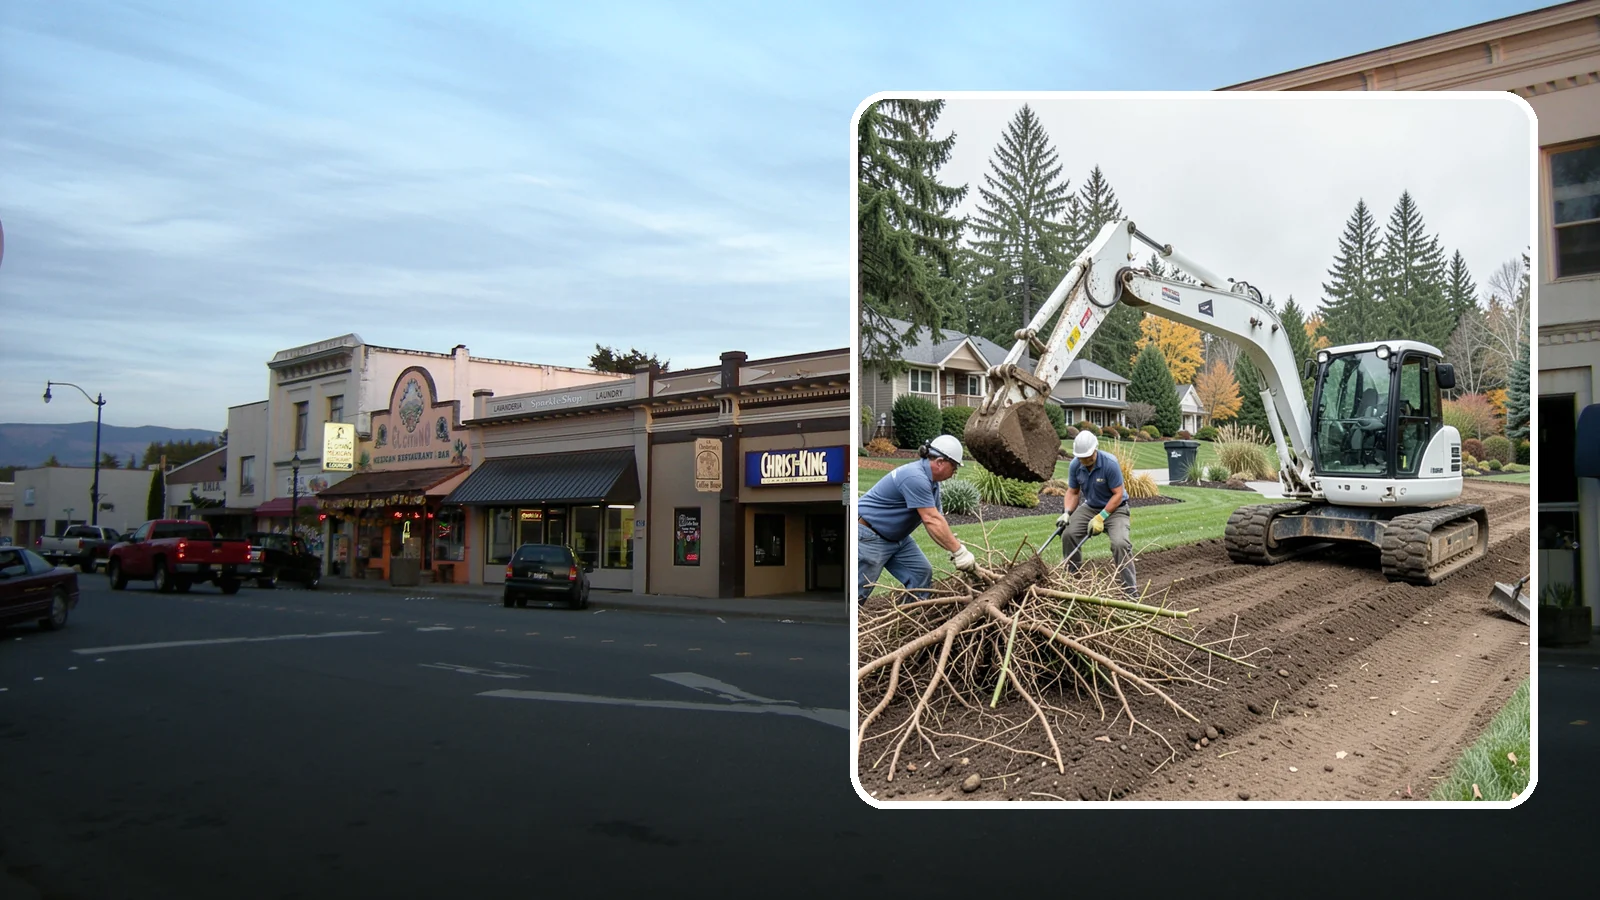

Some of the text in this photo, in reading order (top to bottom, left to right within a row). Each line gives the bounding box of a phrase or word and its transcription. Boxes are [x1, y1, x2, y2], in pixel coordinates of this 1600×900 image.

[494, 402, 523, 413] LAVANDERIA
[595, 389, 623, 400] LAUNDRY
[373, 450, 450, 465] MEXICAN RESTAURANT BAR
[761, 450, 828, 478] CHRIST KING
